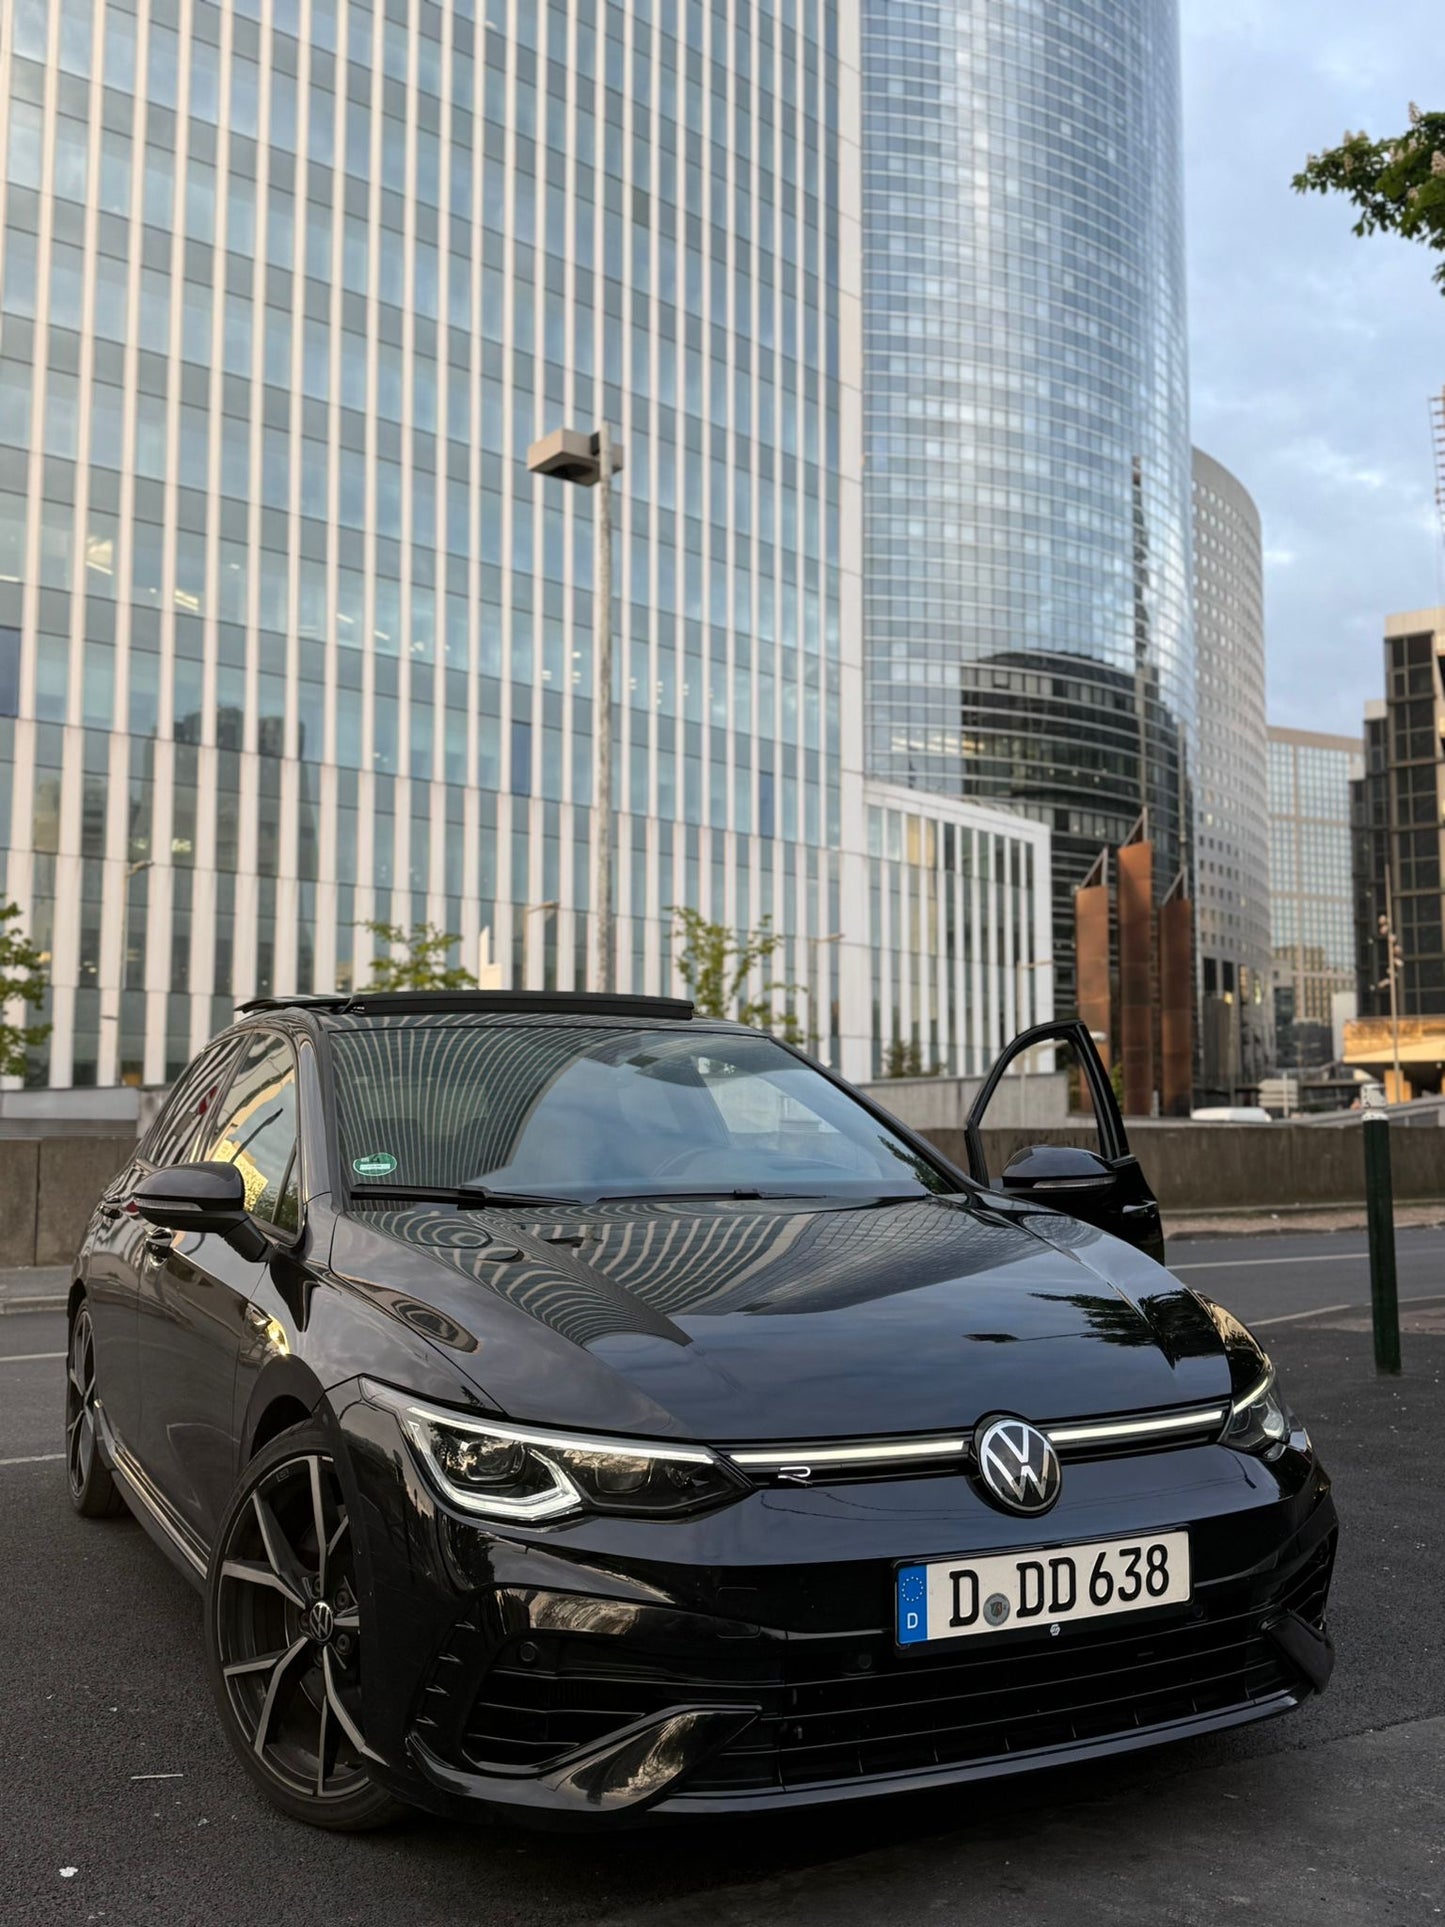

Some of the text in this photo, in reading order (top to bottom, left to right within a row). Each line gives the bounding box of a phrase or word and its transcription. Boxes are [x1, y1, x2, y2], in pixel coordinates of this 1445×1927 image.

[778, 1466, 812, 1487] R
[980, 1420, 1060, 1509] VW
[949, 1569, 979, 1627] D
[1016, 1557, 1076, 1618] DD
[1089, 1544, 1169, 1606] 638
[311, 1602, 333, 1641] VW
[907, 1613, 918, 1629] D
